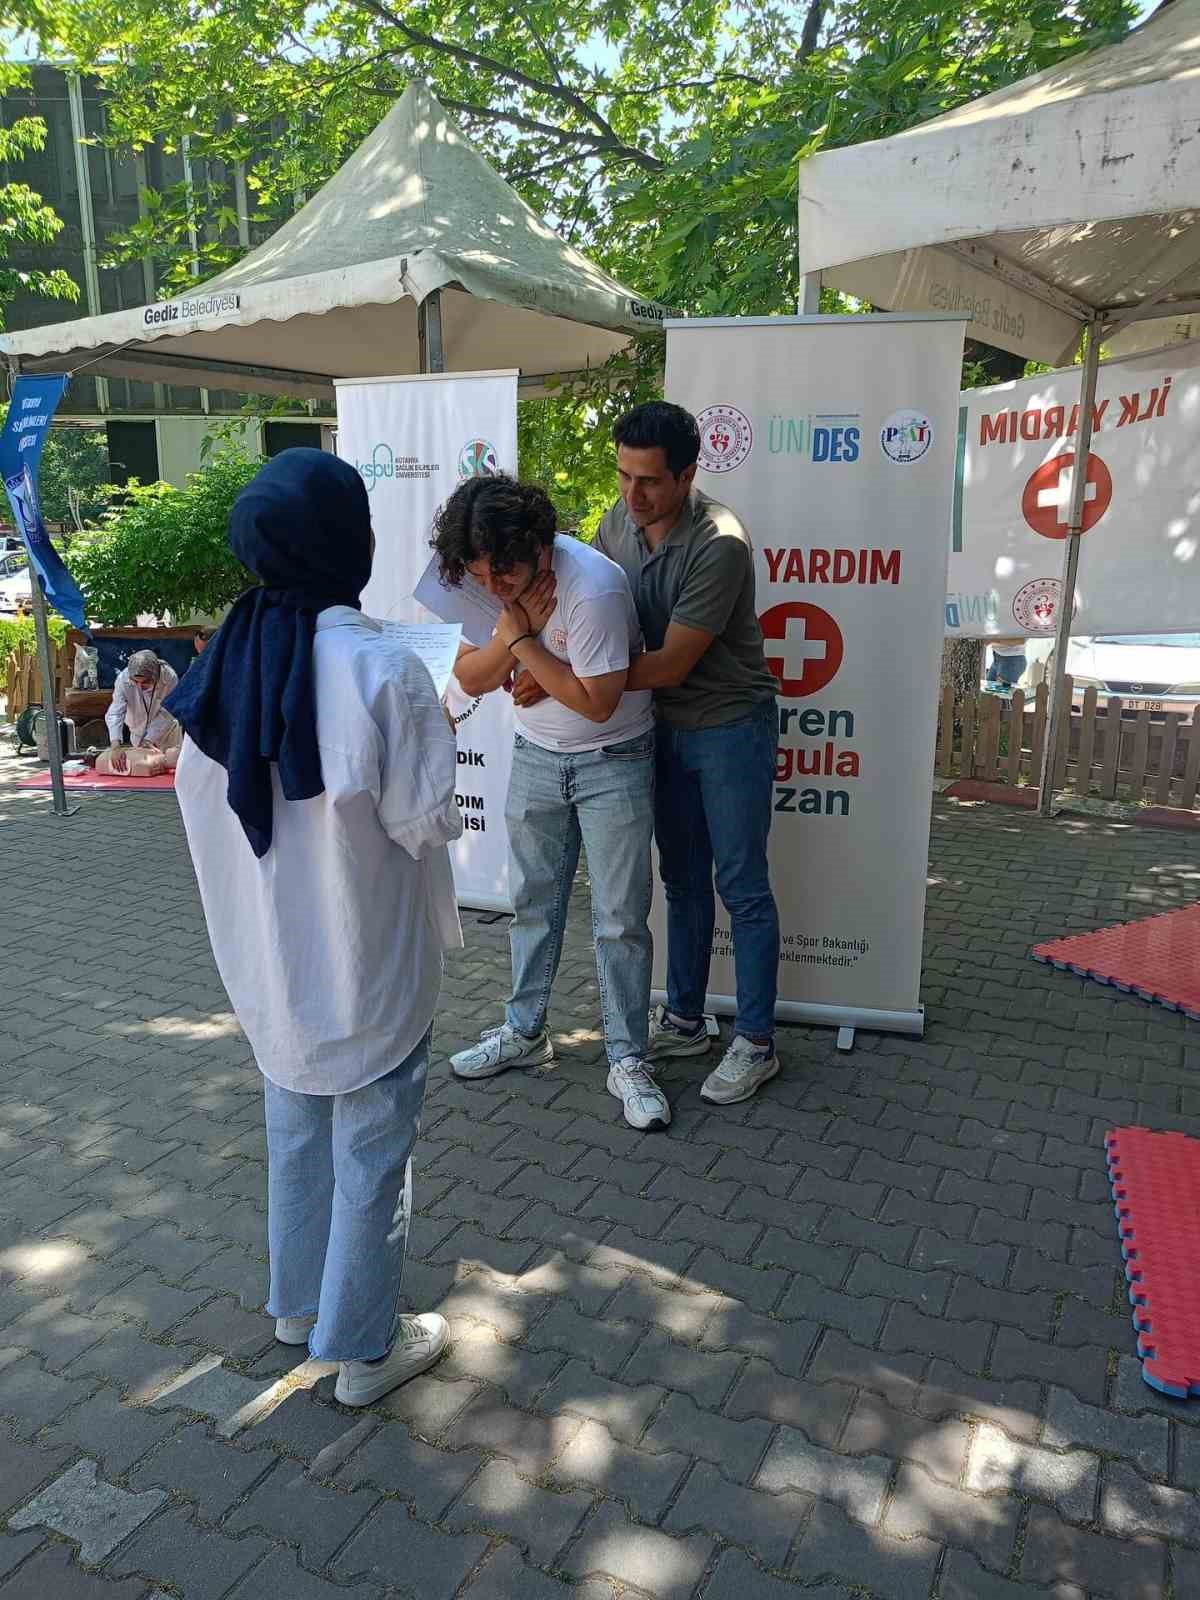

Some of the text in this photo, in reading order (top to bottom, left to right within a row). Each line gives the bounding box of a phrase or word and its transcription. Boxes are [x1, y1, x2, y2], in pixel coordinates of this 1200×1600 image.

[144, 304, 179, 325] Gediz
[630, 300, 664, 321] Gediz
[812, 427, 861, 462] DES
[764, 547, 902, 585] YARDIM
[454, 708, 473, 724] DIM
[779, 707, 855, 738] ren
[456, 748, 486, 767] DİK
[775, 741, 860, 782] gula
[455, 794, 485, 810] DIM
[774, 786, 850, 816] zan
[463, 813, 486, 832] İSİ
[782, 935, 794, 945] ve
[797, 934, 820, 947] Spor
[822, 936, 870, 954] Bakanlığı
[779, 951, 859, 968] eklenmektedir."
